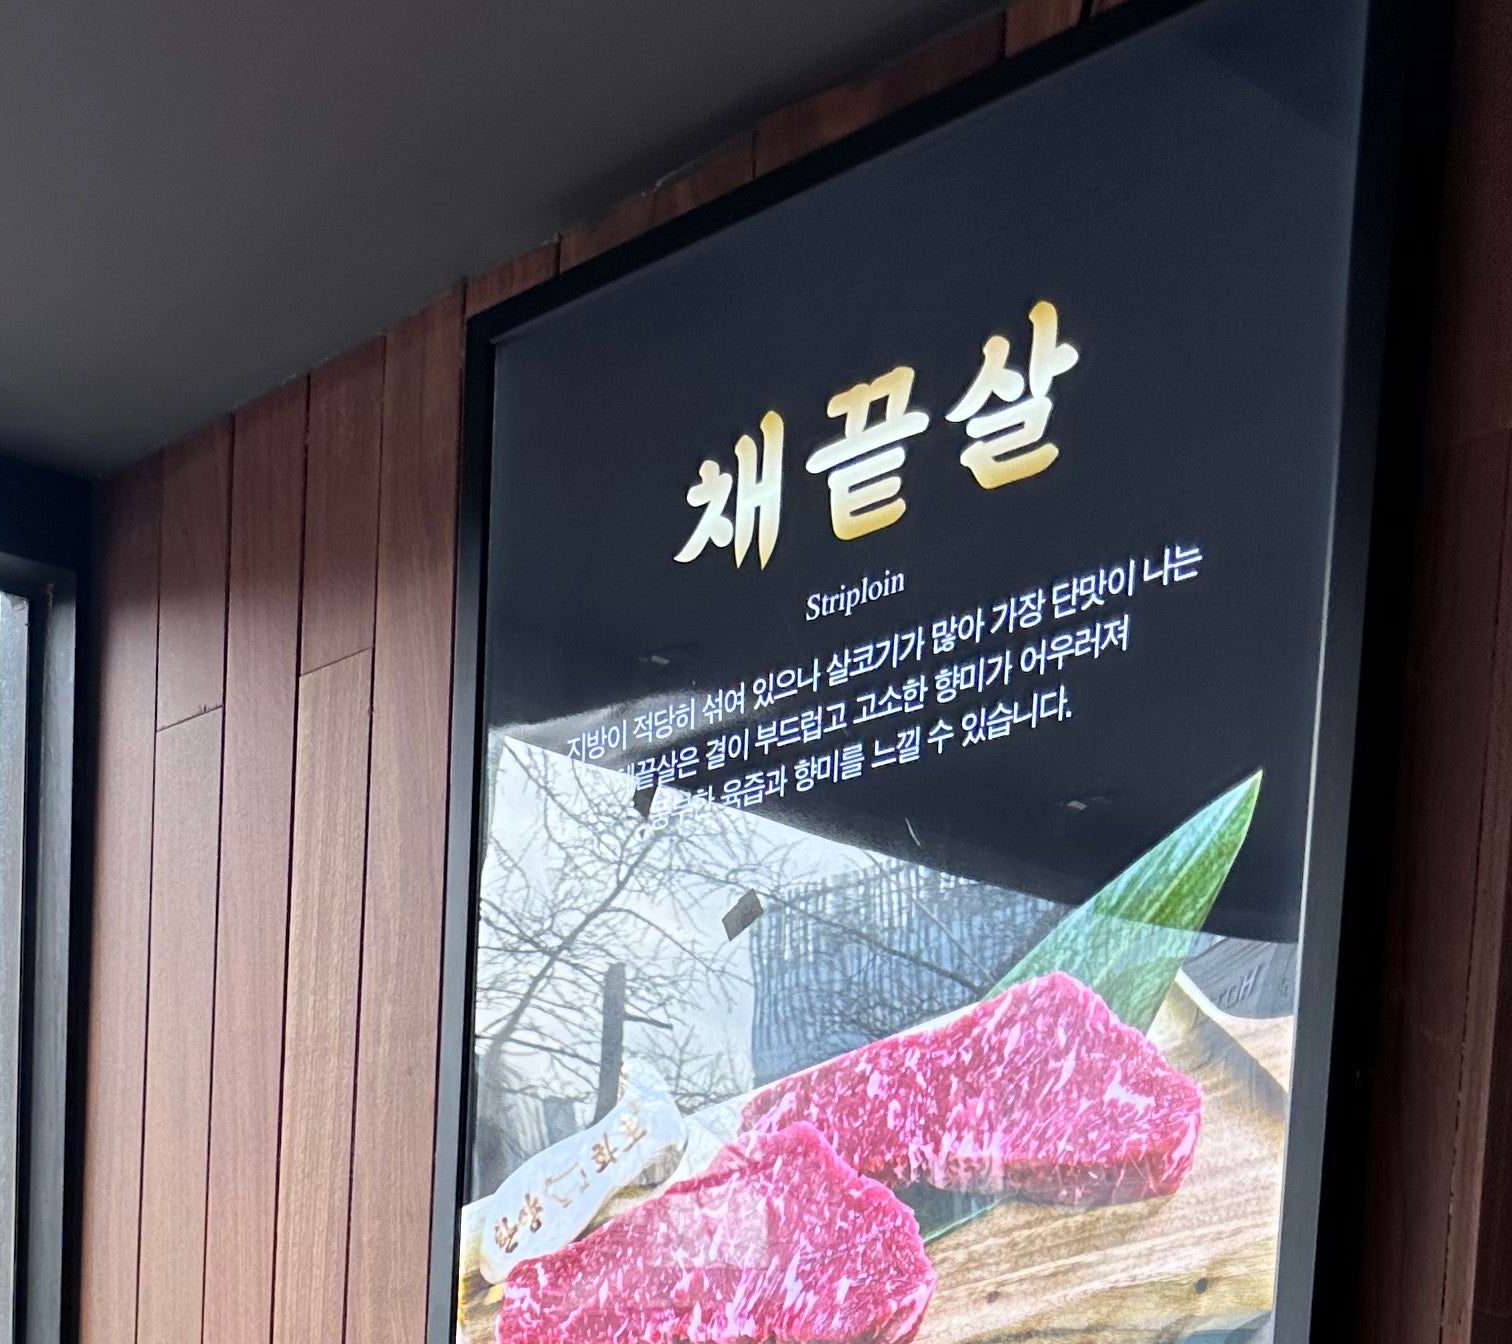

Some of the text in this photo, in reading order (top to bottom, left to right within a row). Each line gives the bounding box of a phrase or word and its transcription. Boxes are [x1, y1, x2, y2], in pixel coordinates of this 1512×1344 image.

[673, 300, 1079, 571] 채끝살
[566, 545, 1203, 762] 지방이 적당히 섞여 있으나 살코기가 많아 가장 단맛이 나는
[805, 570, 906, 621] Striploin
[705, 728, 749, 771] 결이
[754, 701, 847, 749] 부드럽고
[852, 674, 929, 725] 고소한
[934, 649, 1013, 704] 향미가
[1019, 613, 1131, 676] 어우러져
[719, 765, 788, 809] 육즙과
[794, 743, 865, 792] 향미를
[870, 725, 921, 769] 느낄
[927, 718, 955, 754] 수
[961, 683, 1072, 747] 있습니다.
